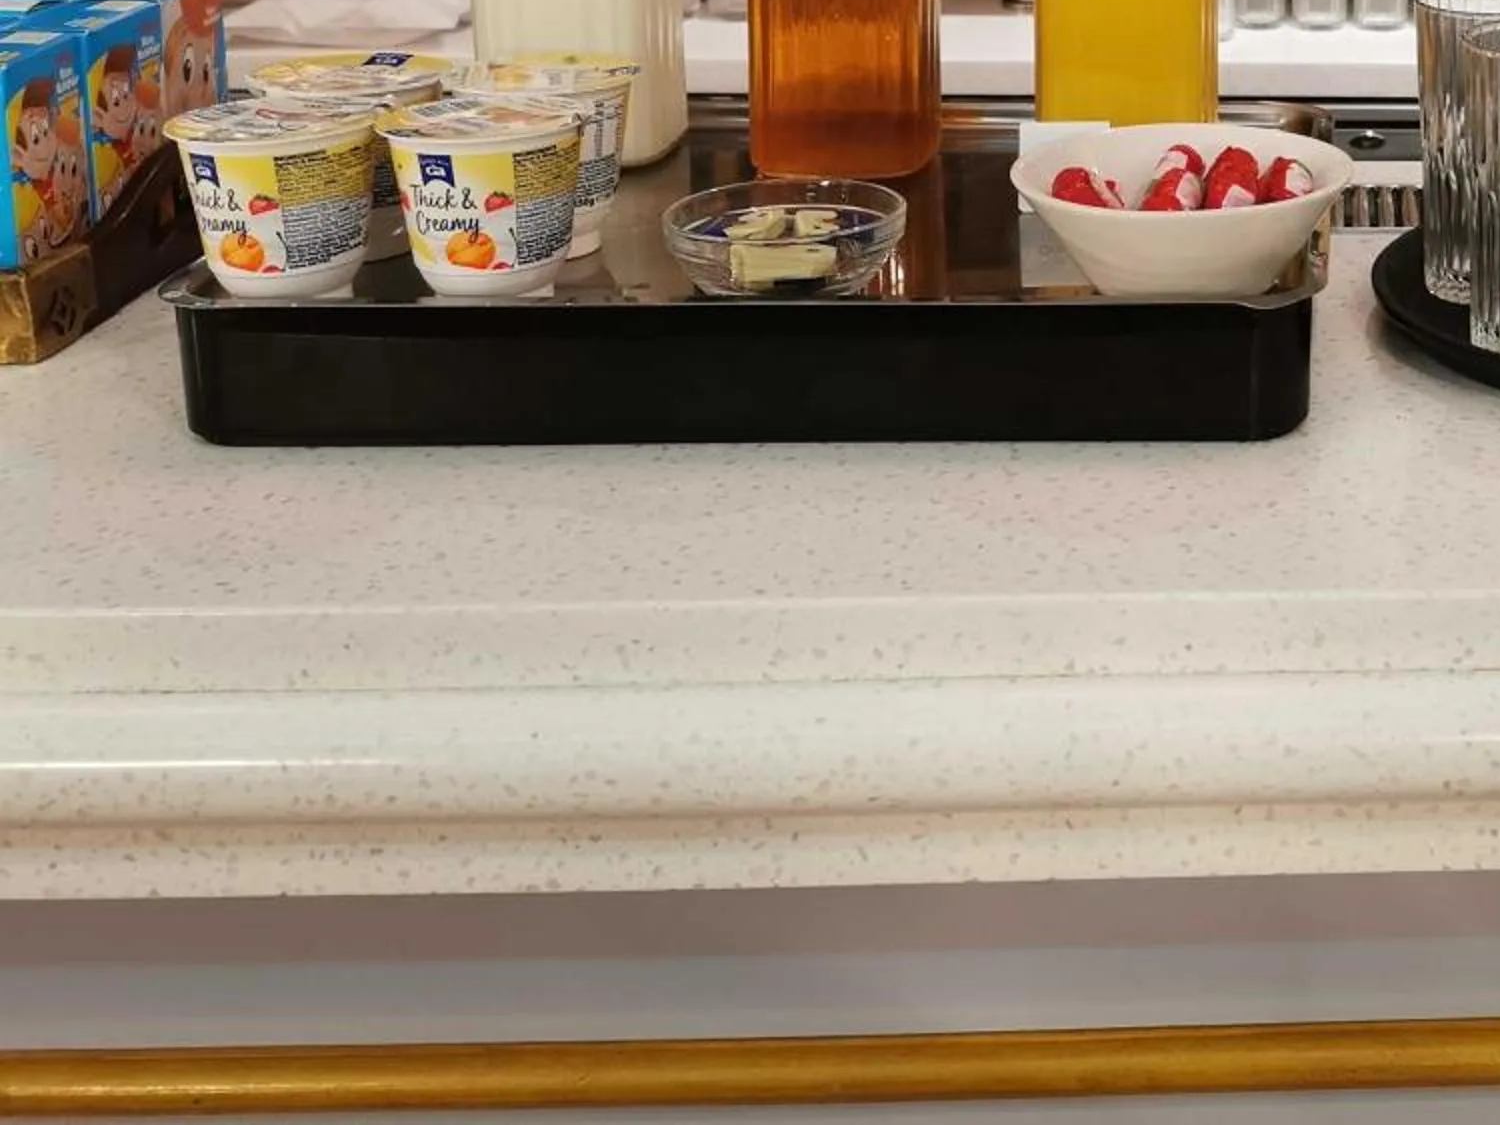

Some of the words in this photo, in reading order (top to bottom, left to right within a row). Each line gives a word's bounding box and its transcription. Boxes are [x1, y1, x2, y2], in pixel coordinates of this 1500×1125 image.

[227, 188, 243, 212] &
[409, 183, 458, 210] Thick
[461, 186, 478, 210] &
[415, 209, 481, 244] Creamy
